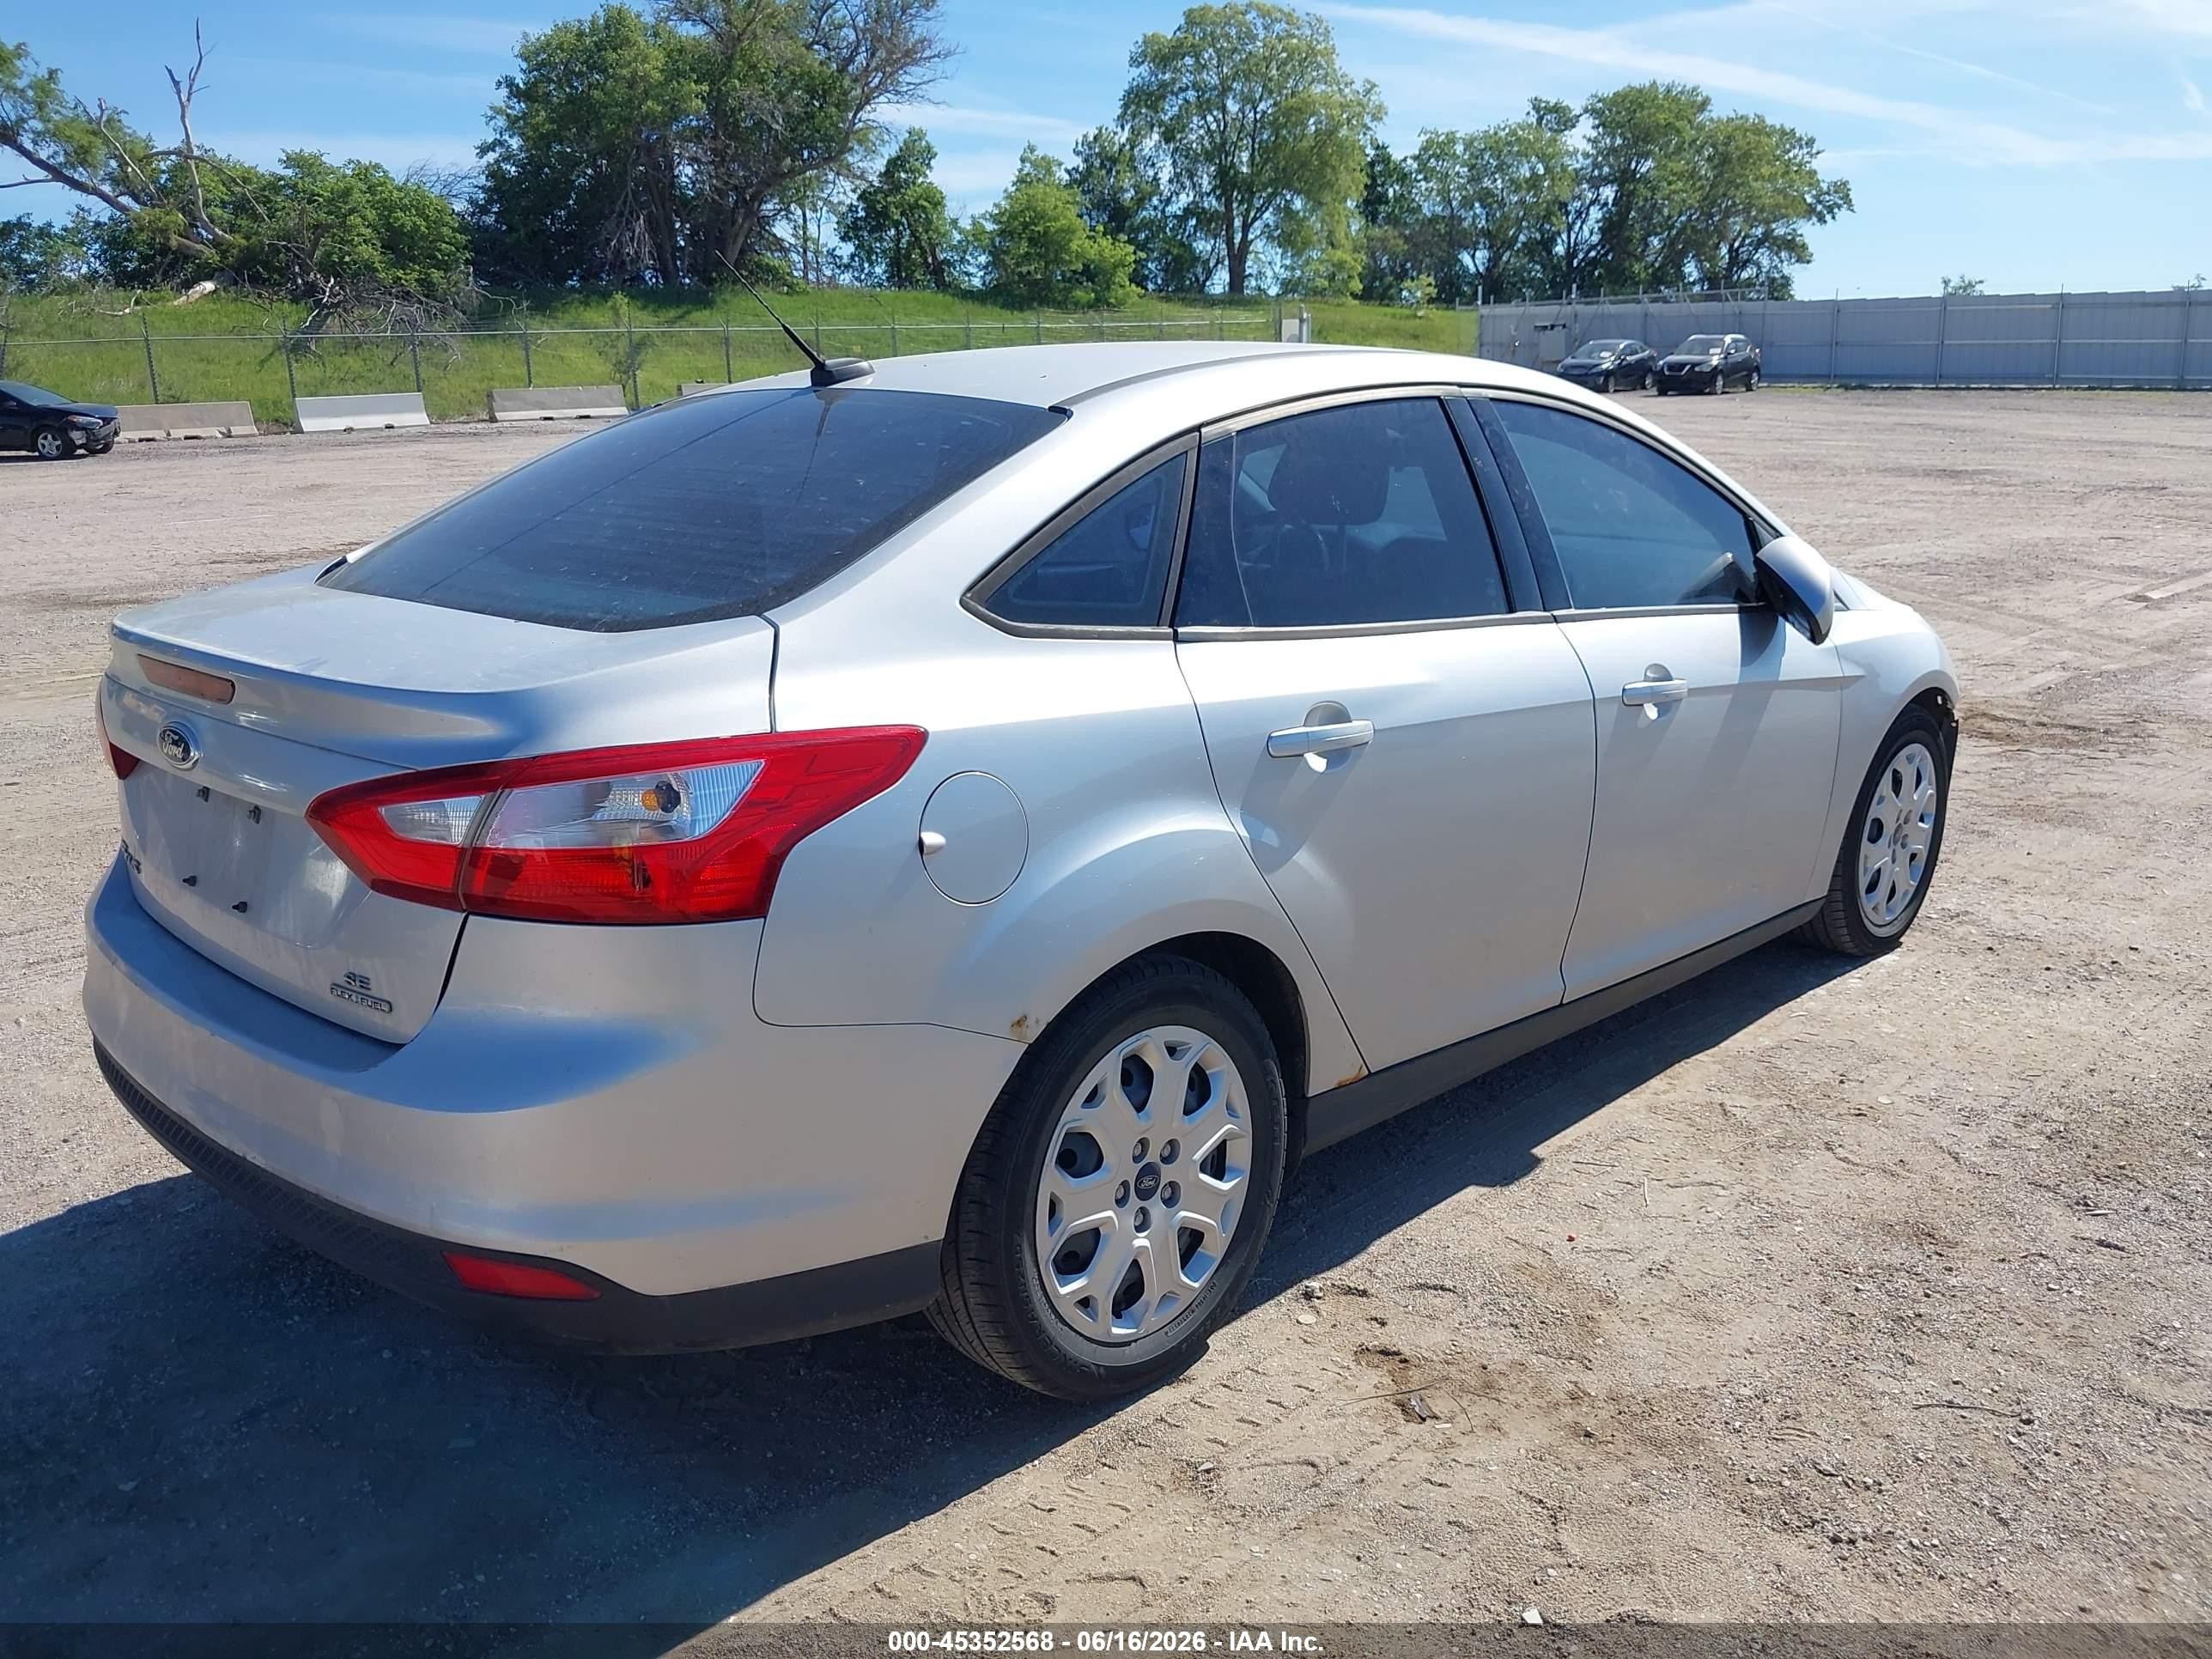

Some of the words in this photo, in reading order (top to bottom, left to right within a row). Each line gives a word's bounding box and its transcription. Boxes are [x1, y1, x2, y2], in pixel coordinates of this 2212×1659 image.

[161, 730, 184, 759] Ford
[343, 971, 371, 990] SE
[331, 987, 354, 1003] FLEX
[361, 997, 386, 1012] FUEL
